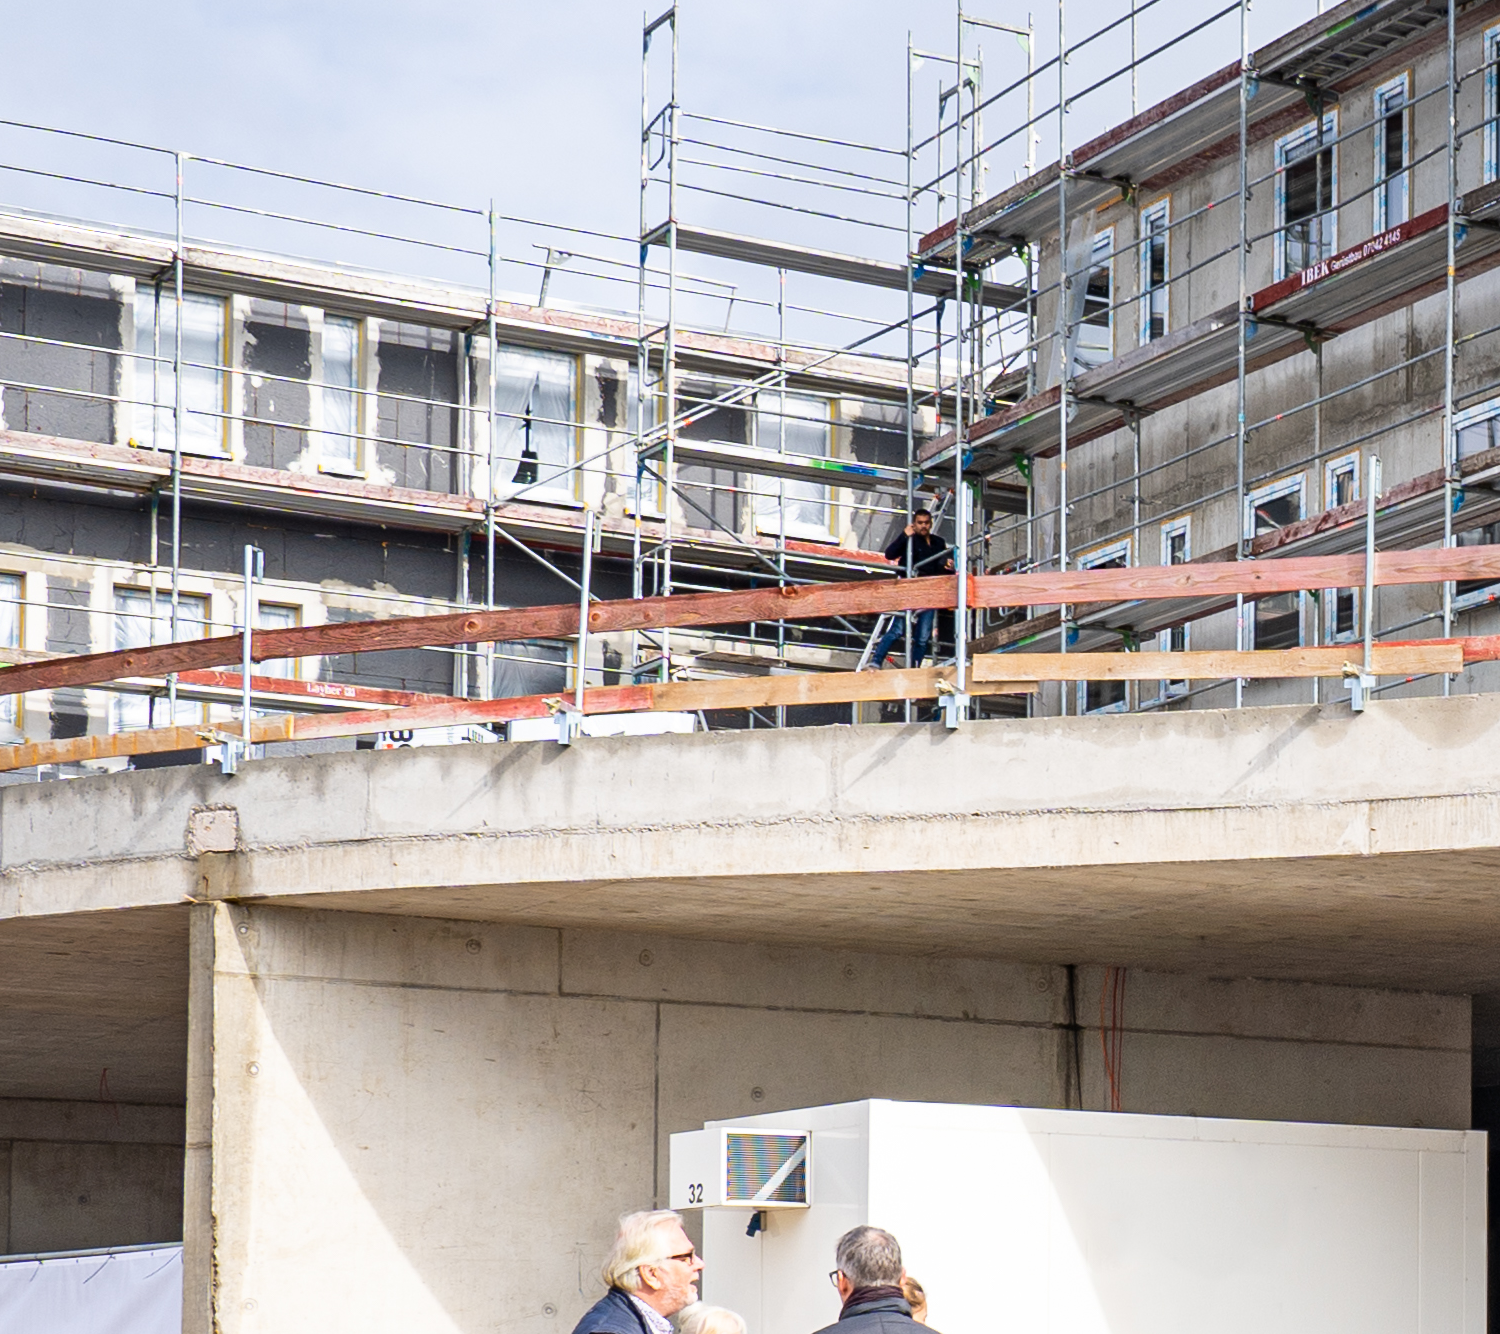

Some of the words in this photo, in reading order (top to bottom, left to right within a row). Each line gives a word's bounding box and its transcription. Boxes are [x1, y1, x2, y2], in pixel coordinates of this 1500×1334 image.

[1300, 260, 1329, 287] IBEK
[1362, 238, 1383, 257] 07042
[1383, 228, 1401, 245] 4145
[306, 682, 342, 698] Layher
[689, 1183, 704, 1204] 32
